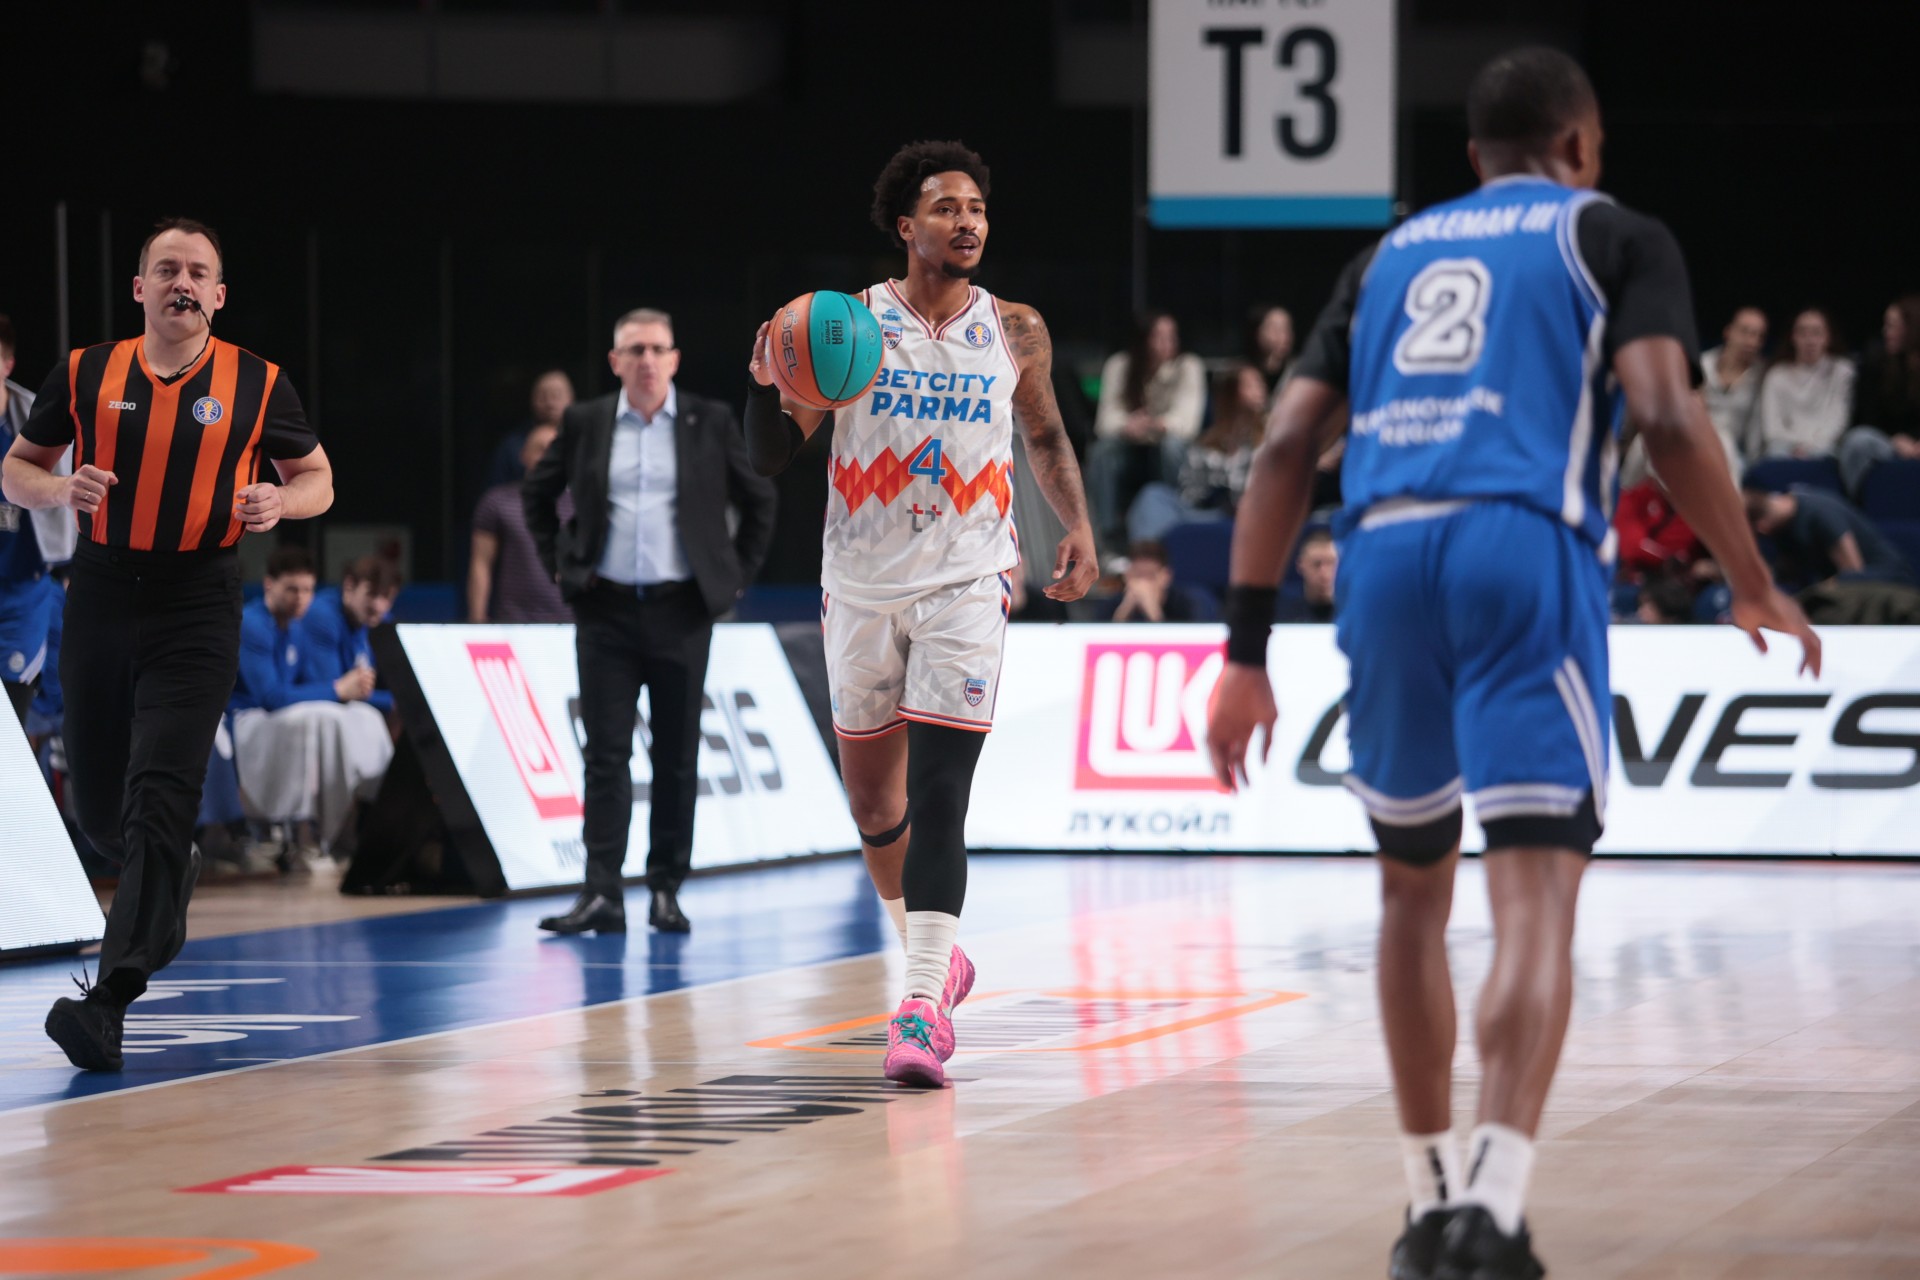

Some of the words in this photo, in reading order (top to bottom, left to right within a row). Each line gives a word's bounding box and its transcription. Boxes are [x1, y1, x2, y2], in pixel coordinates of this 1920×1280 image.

[1203, 27, 1338, 160] T3
[831, 320, 844, 345] FIBA
[1394, 257, 1492, 376] 2
[874, 367, 997, 394] BETCITY
[108, 400, 137, 411] ZEDO
[870, 391, 992, 424] PARMA
[908, 438, 947, 485] 4
[1069, 803, 1232, 835] ЛУКОЙЛ
